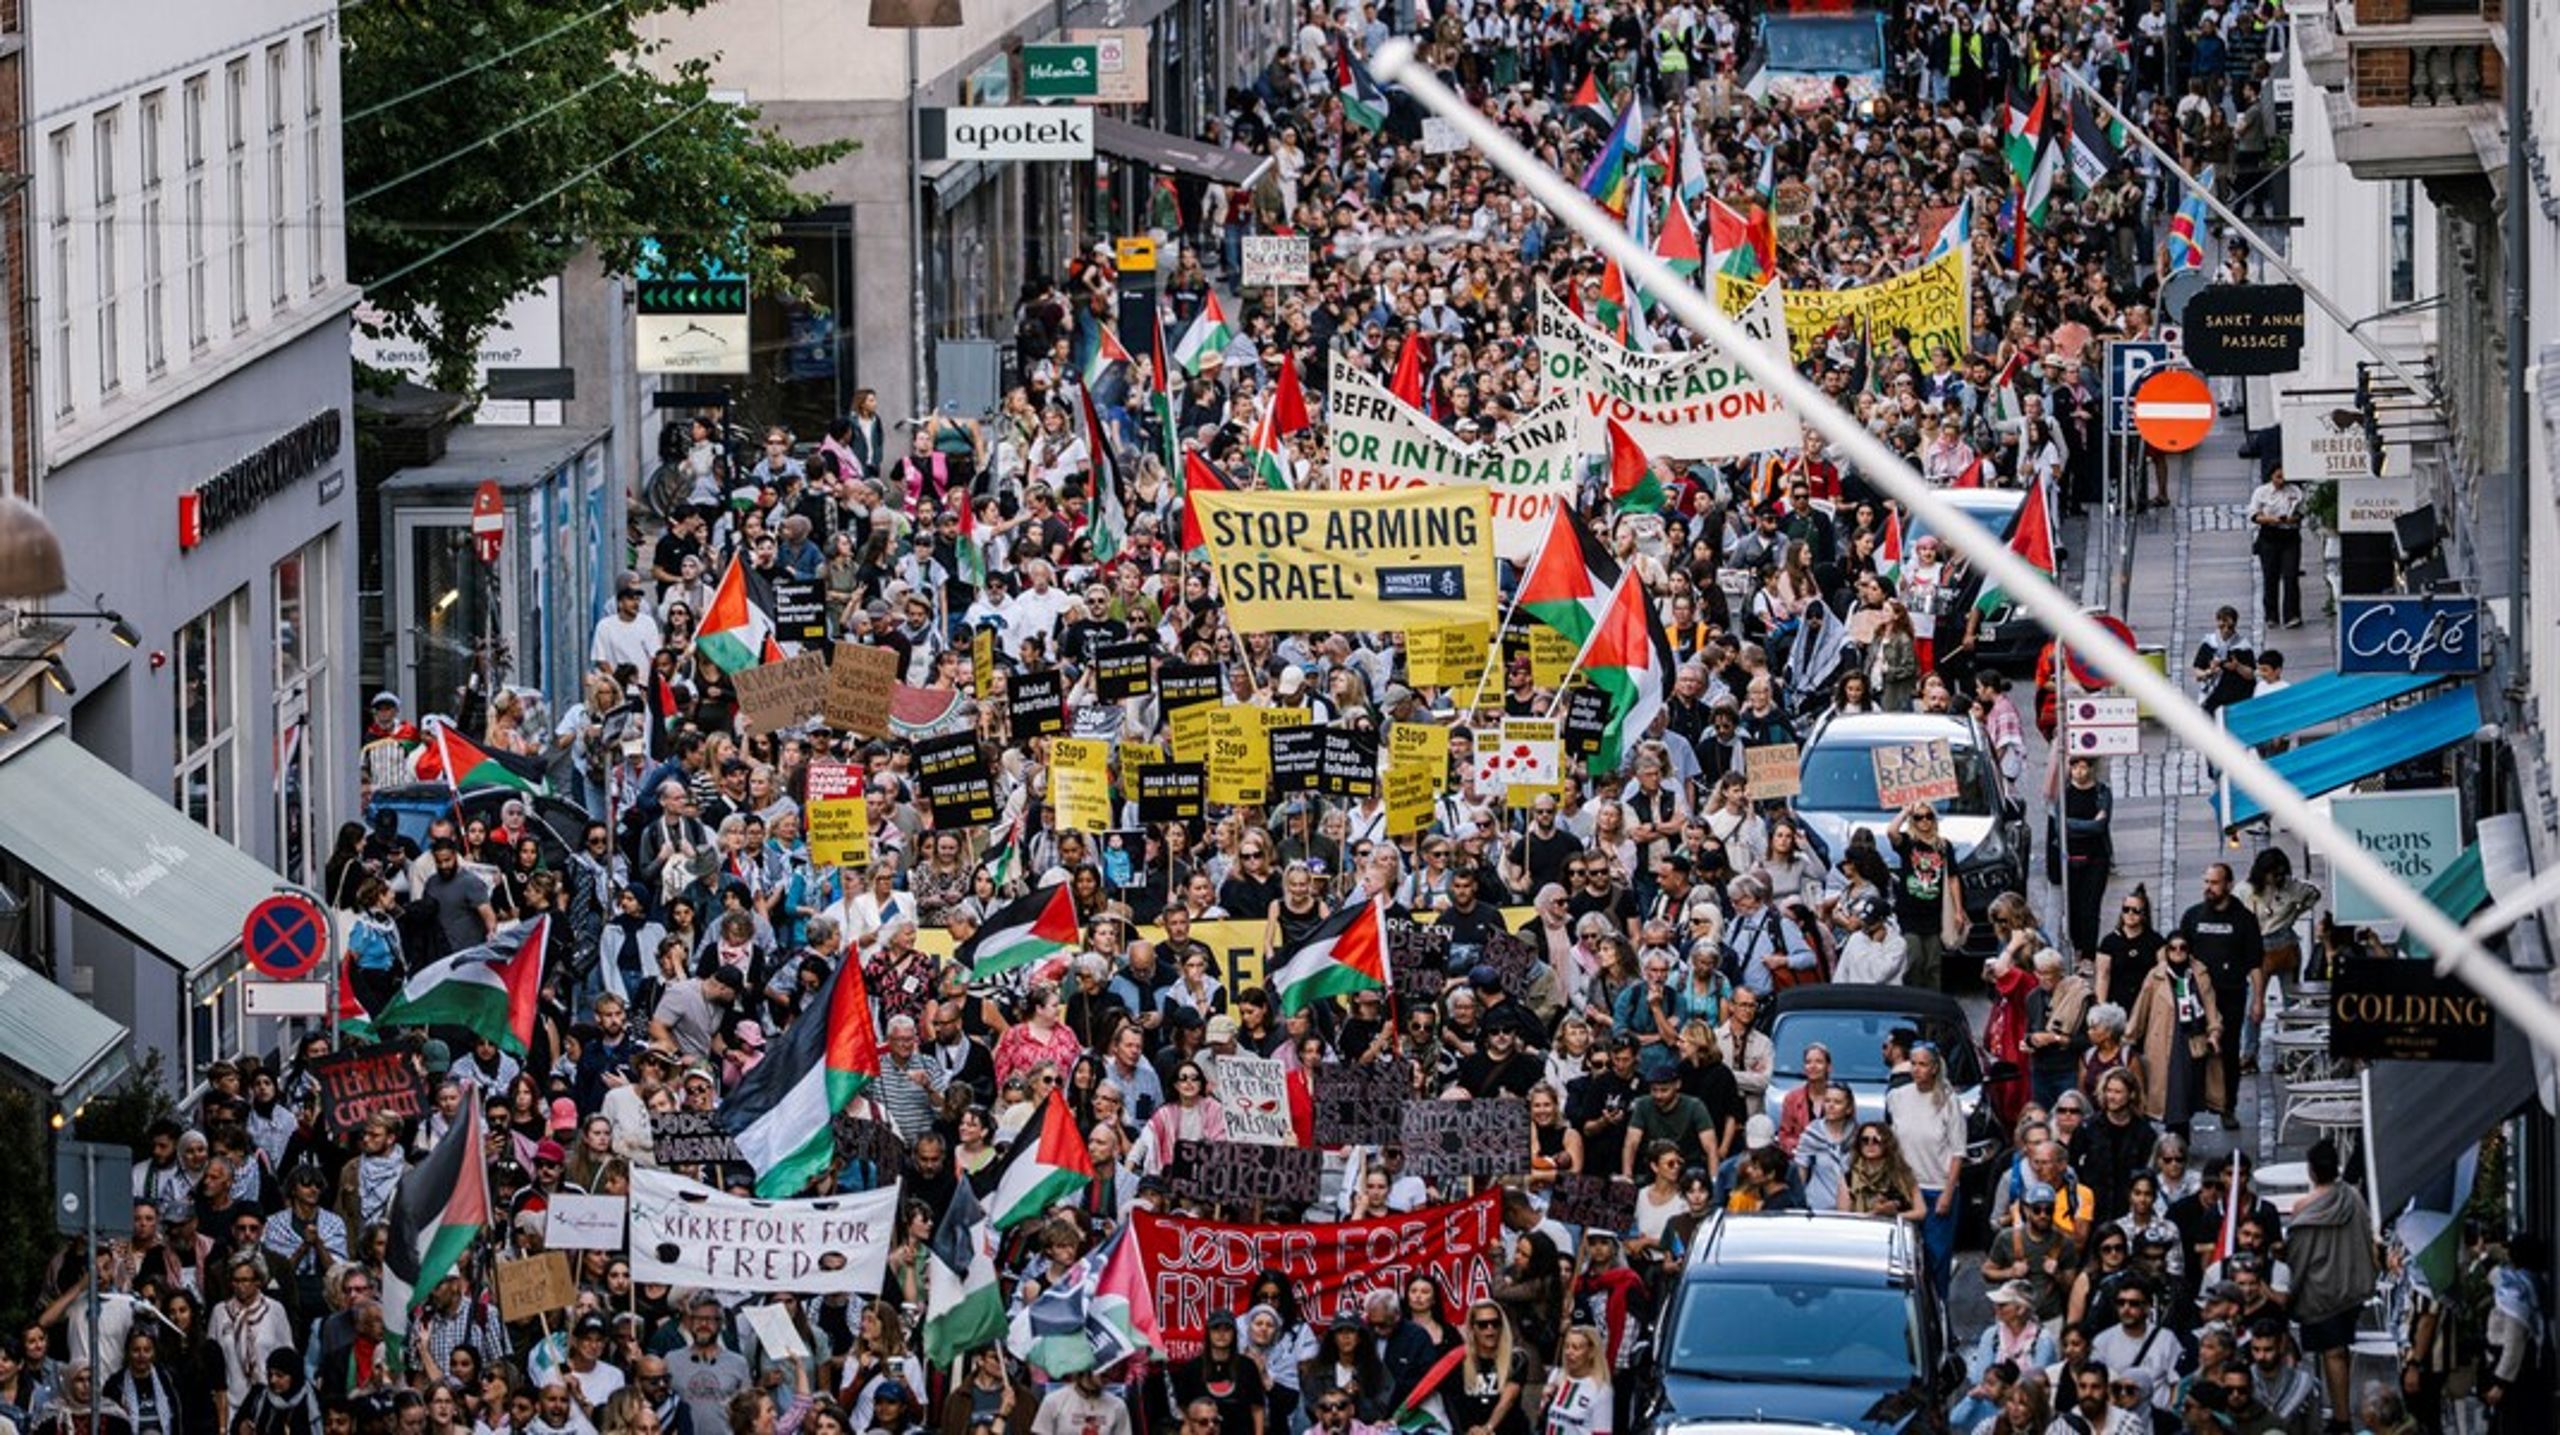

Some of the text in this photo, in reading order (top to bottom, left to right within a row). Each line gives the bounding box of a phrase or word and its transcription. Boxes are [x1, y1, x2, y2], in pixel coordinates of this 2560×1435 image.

[955, 119, 1084, 150] apotek
[2205, 315, 2251, 326] SANKT
[2222, 335, 2288, 348] PASSAGE
[2310, 438, 2366, 452] HEREFO
[2326, 455, 2368, 470] STEAK
[1213, 506, 1477, 550] STOP ARMING
[1220, 562, 1353, 601] ISRAEL
[1385, 574, 1431, 586] AMNESTY
[2349, 604, 2472, 673] Café
[1012, 694, 1060, 715] apartheid
[1260, 712, 1303, 726] Beskyt
[1325, 735, 1349, 749] Stop
[1396, 727, 1428, 746] Stop
[1054, 742, 1087, 760] Stop
[1216, 739, 1248, 757] Stop
[1325, 751, 1360, 763] Israels
[1323, 763, 1374, 778] folkedrab
[812, 808, 852, 819] Stop den
[2336, 992, 2488, 1026] COLDING
[664, 1215, 870, 1244] KIRKEFOLK FOR
[1157, 1218, 1318, 1277] JØDER
[1336, 1221, 1429, 1271] FOR
[1443, 1199, 1495, 1254] ET
[707, 1246, 812, 1281] FRED
[1156, 1272, 1249, 1333] FRIT
